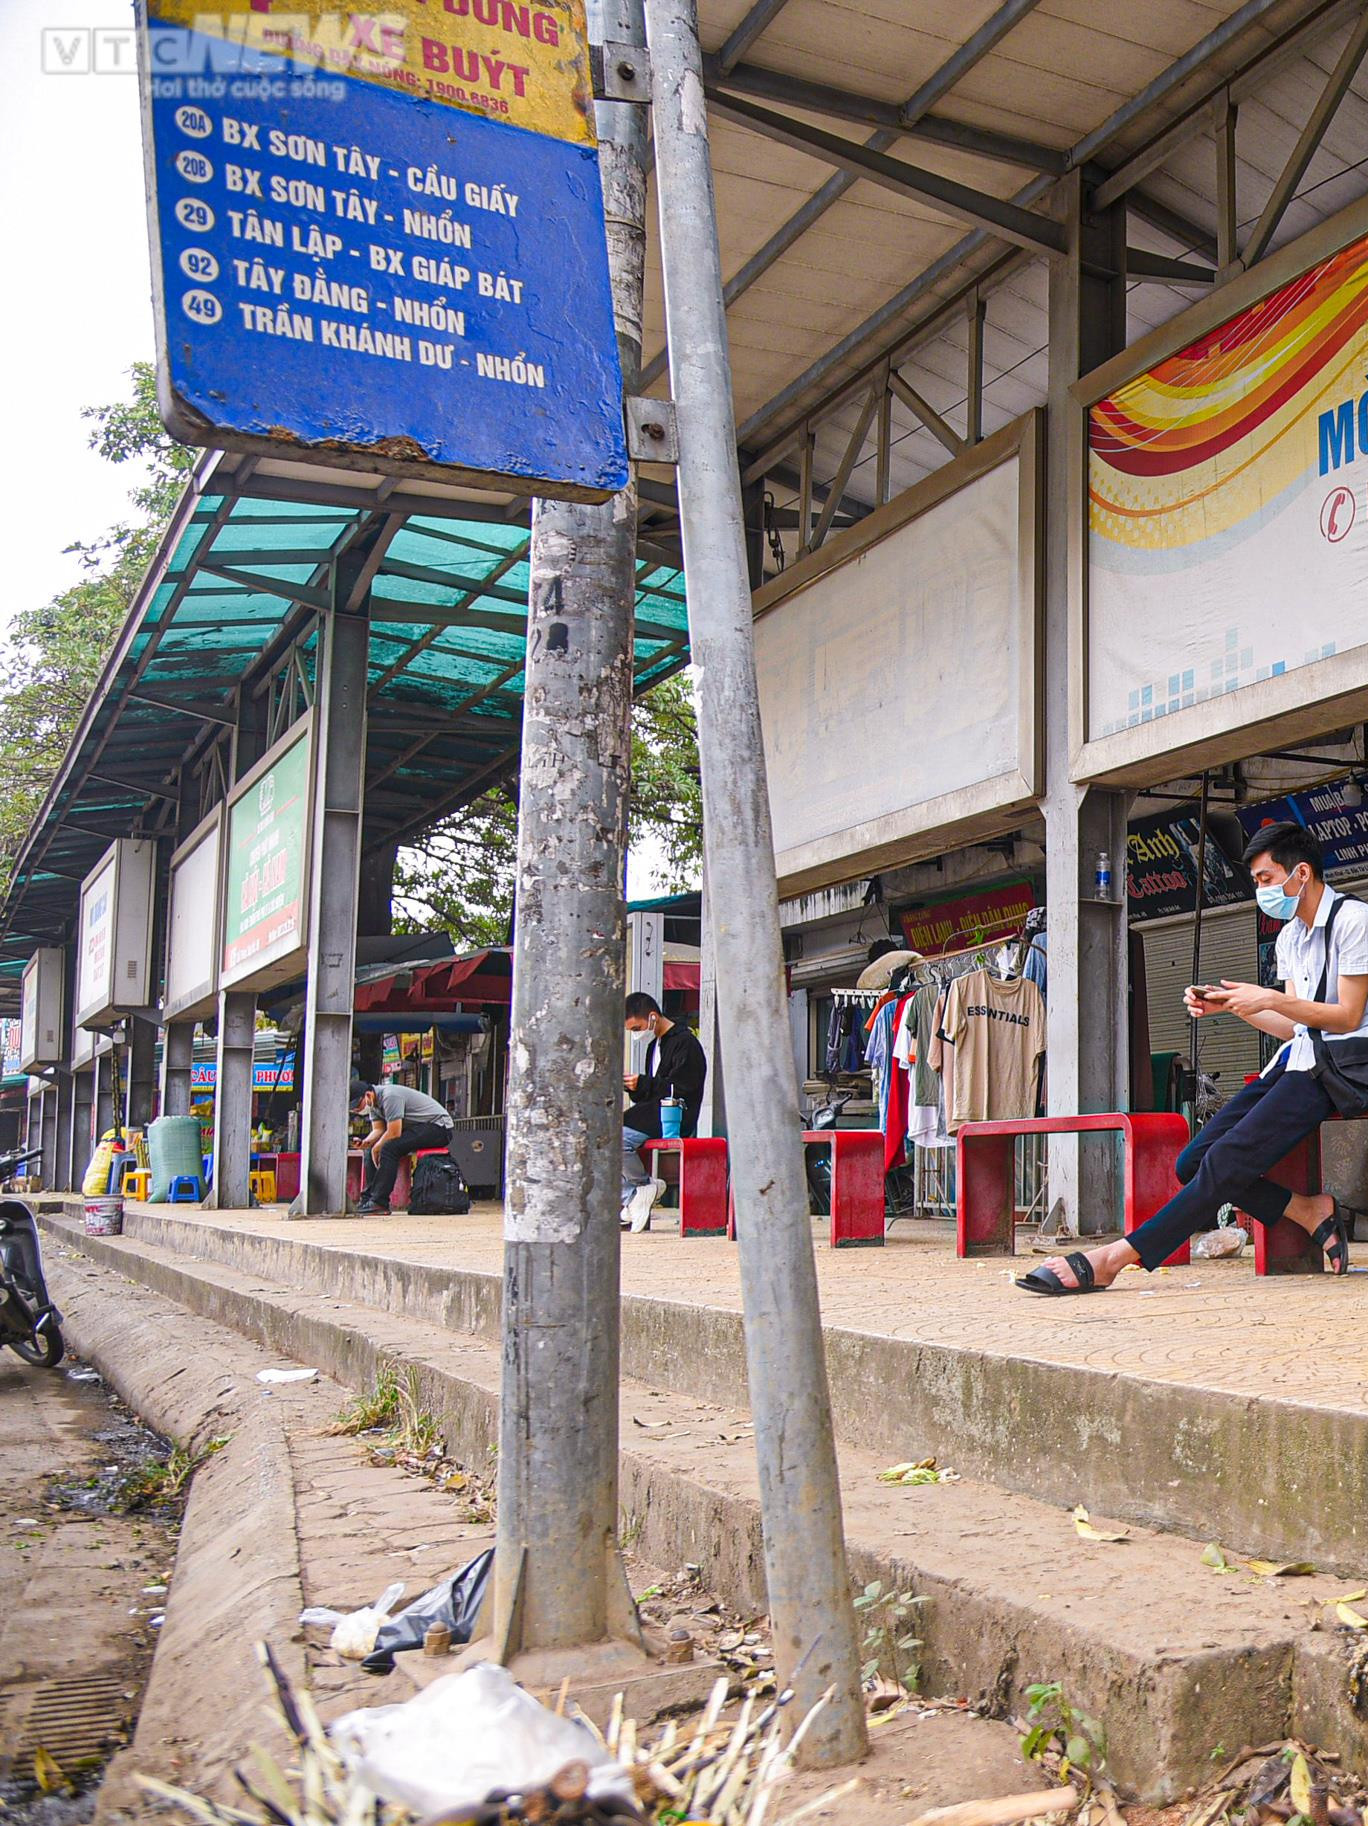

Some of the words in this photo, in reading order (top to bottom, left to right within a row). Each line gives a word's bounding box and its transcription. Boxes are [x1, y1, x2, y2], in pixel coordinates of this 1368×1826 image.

[422, 37, 530, 98] BUÝT
[425, 78, 509, 114] 1900.6836
[181, 110, 207, 134] 20A
[222, 116, 261, 150] BX
[269, 130, 326, 167] SƠN
[333, 146, 380, 180] TÂY
[407, 163, 457, 201] CẦU
[464, 183, 519, 217] GIẤY
[182, 156, 207, 177] 20B
[225, 163, 263, 198] BX
[270, 175, 326, 212] SƠN
[332, 189, 378, 225] TÂY
[403, 208, 471, 249] NHỔN
[183, 203, 207, 225] 29
[227, 209, 284, 247] TÂN
[292, 224, 342, 262] LẬP
[369, 244, 405, 277] BX
[412, 257, 470, 290] GIÁP
[478, 271, 523, 304] BÁT
[187, 253, 212, 276] 92
[233, 257, 284, 295] TÂY
[293, 266, 369, 314] ĐẰNG
[394, 296, 465, 336] NHỔN
[189, 295, 216, 318] 49
[239, 302, 313, 342] TRẦN
[321, 320, 412, 362] KHÁNH
[418, 340, 455, 369] DƯ
[476, 351, 545, 388] NHỔN
[1308, 816, 1353, 842] LAPTOP
[1334, 845, 1357, 862] LINH
